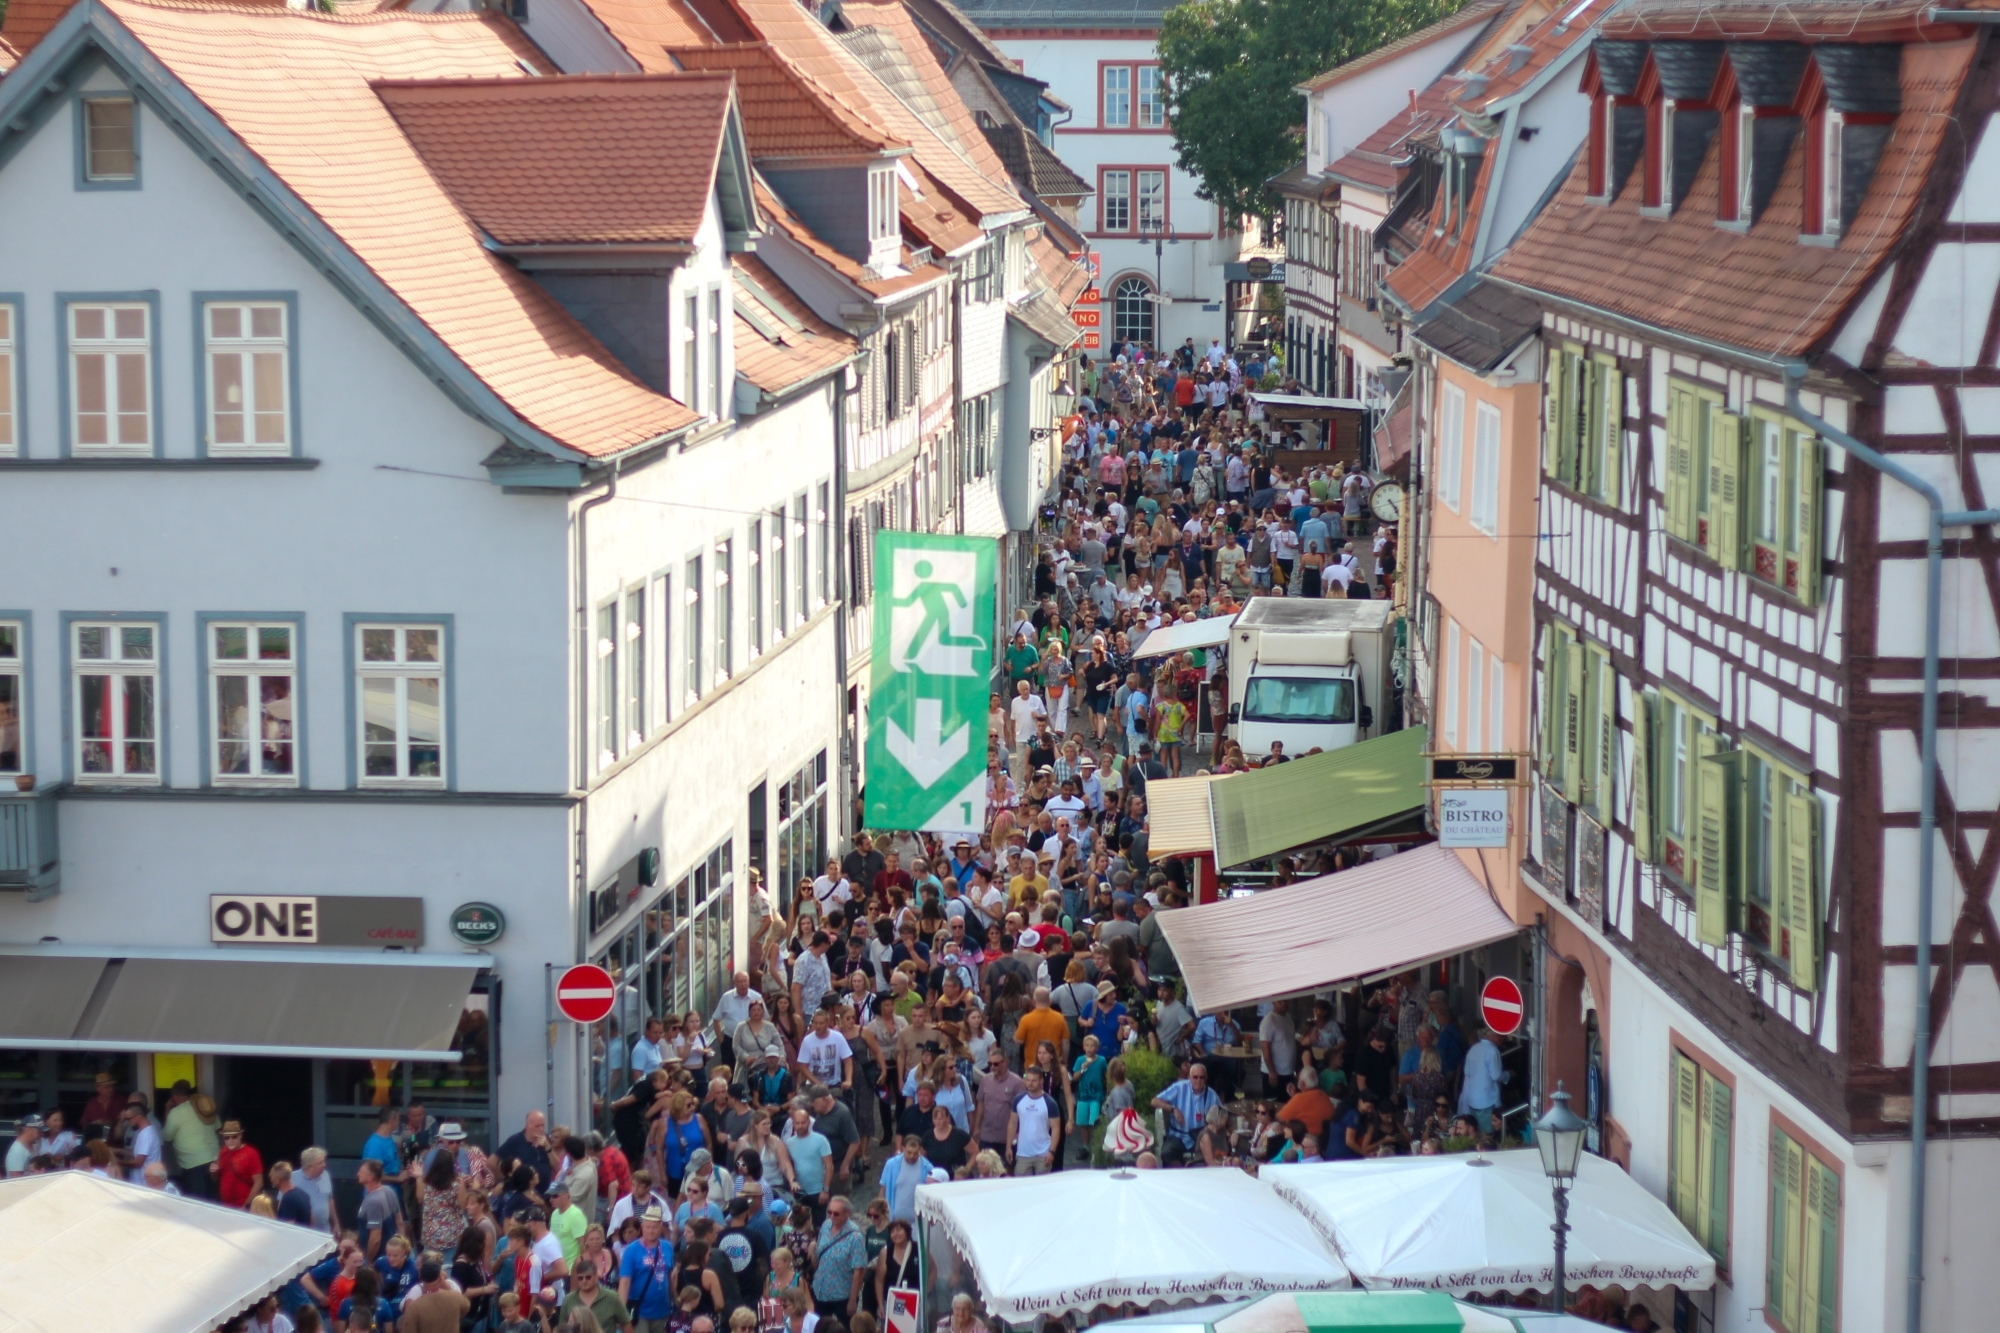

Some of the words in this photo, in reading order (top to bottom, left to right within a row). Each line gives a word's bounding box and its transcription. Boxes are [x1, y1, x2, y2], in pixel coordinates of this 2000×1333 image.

[1074, 314, 1097, 323] INO
[960, 801, 972, 826] 1
[1446, 810, 1503, 822] BISTRO
[1461, 825, 1503, 834] CHÂTEAU
[215, 901, 314, 937] ONE
[457, 921, 496, 930] BECK'S
[1391, 1276, 1426, 1289] Wein
[1431, 1275, 1442, 1289] &
[1447, 1273, 1477, 1288] Sekt
[1480, 1275, 1506, 1285] von
[1510, 1270, 1533, 1284] der
[1619, 1264, 1699, 1284] Bergstraße
[1012, 1296, 1051, 1312] Wein
[1056, 1291, 1067, 1307] &
[1072, 1286, 1103, 1304] Sekt
[1107, 1286, 1132, 1298] von
[1137, 1281, 1161, 1296] der
[1166, 1275, 1245, 1295] Hessischen
